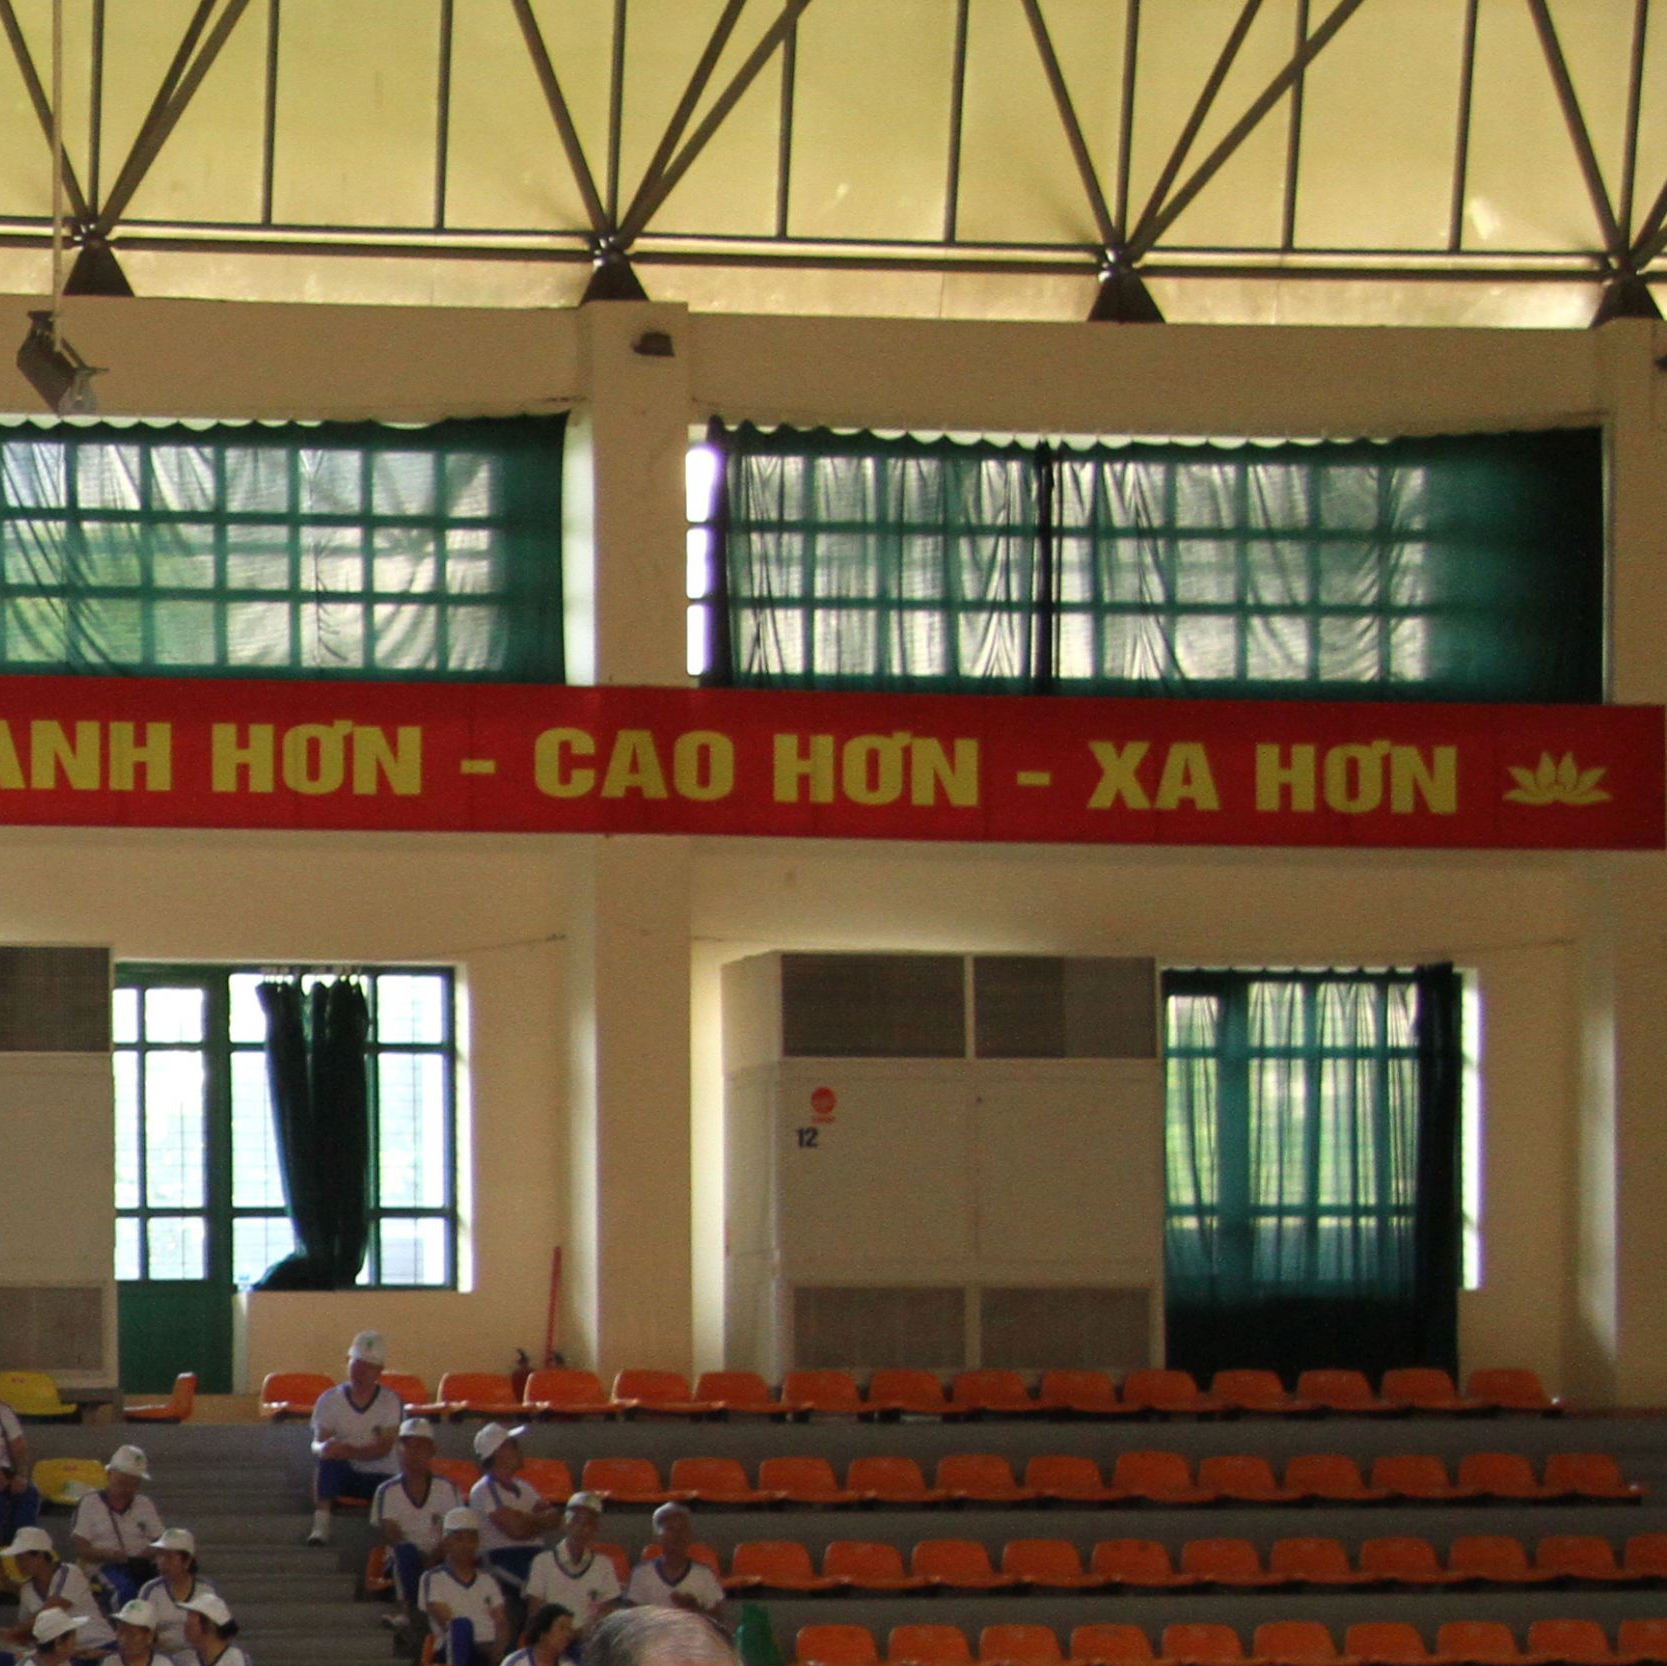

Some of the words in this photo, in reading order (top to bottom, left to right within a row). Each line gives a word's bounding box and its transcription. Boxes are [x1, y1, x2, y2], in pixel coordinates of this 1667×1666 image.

[212, 720, 421, 795] HƠN
[535, 728, 734, 800] CAO
[774, 732, 978, 806] HƠN
[1089, 741, 1219, 810] XA
[1256, 740, 1457, 813] HƠN
[797, 1127, 818, 1148] 12
